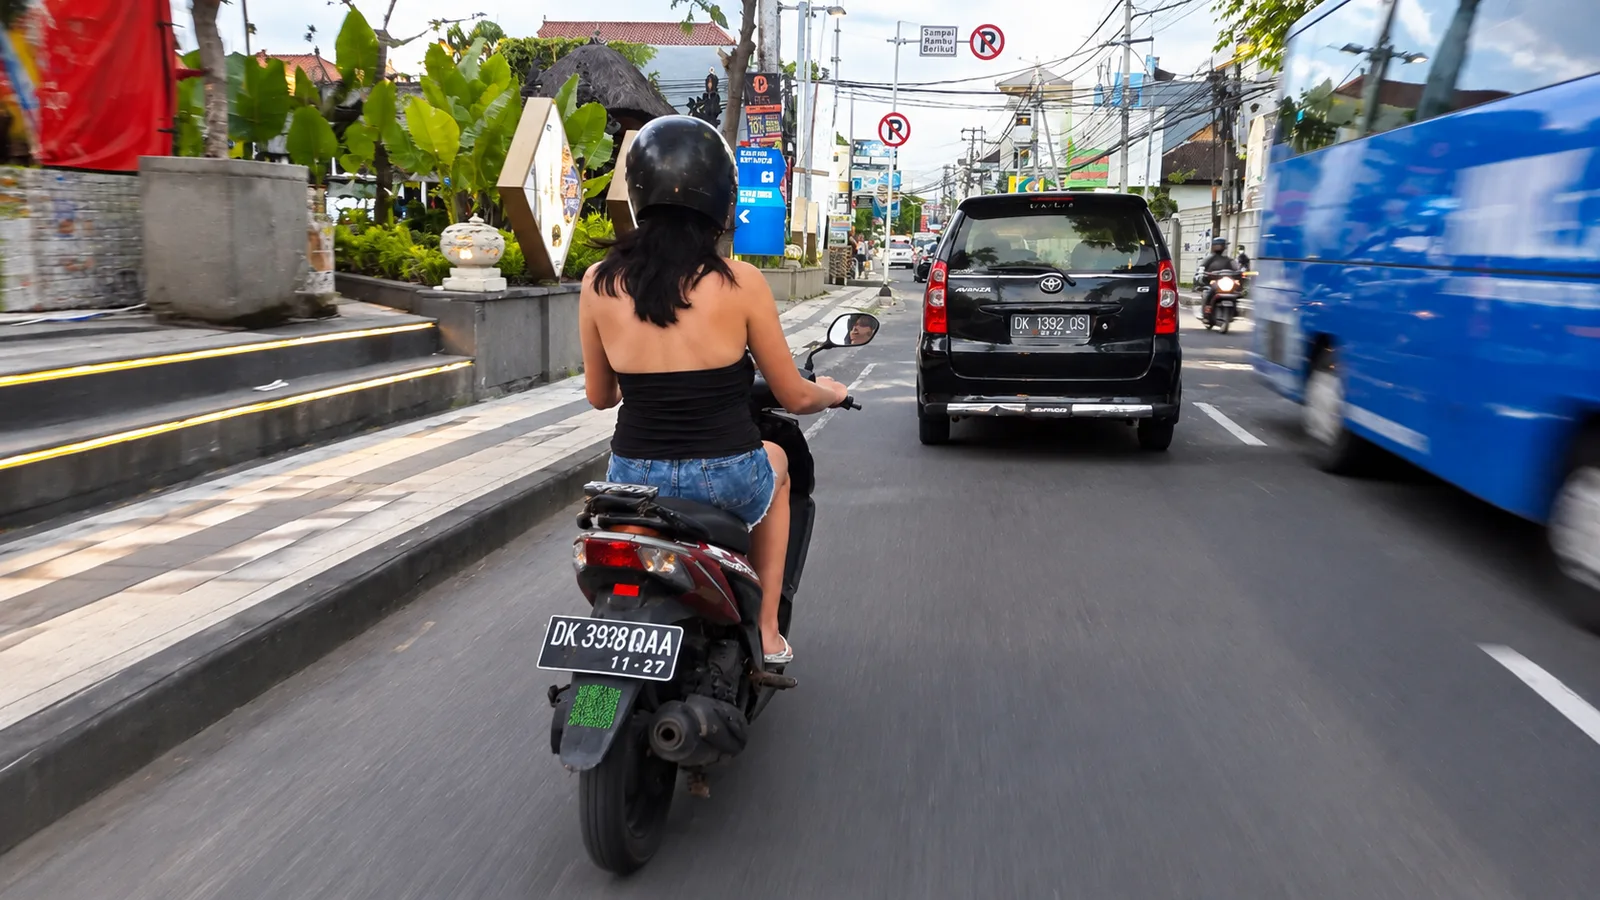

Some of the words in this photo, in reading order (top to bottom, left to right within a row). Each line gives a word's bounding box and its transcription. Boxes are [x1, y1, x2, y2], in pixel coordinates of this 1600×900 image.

[1014, 316, 1030, 330] DK
[1037, 316, 1064, 330] 1392
[1069, 316, 1085, 330] QS
[550, 621, 581, 647] DK
